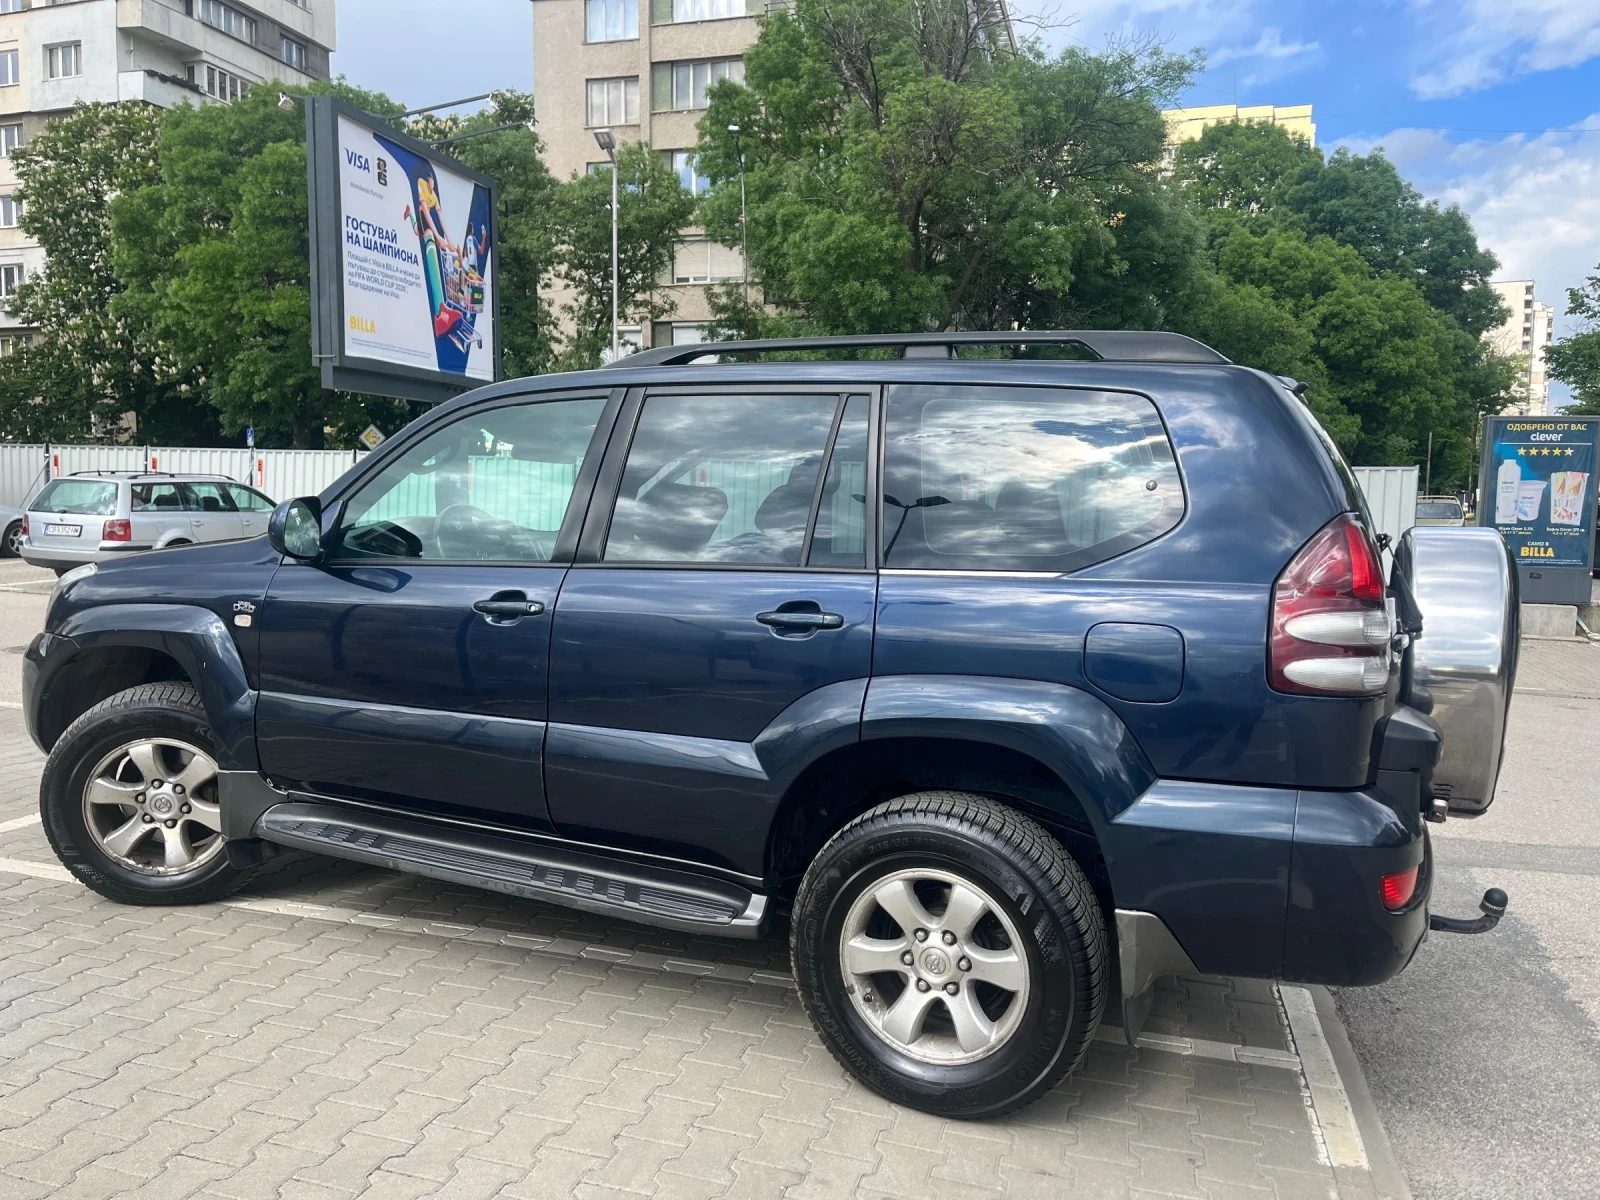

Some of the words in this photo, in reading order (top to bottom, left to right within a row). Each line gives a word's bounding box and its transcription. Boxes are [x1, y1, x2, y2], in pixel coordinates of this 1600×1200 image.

[344, 148, 370, 173] VISA
[346, 215, 398, 244] ГОСТУВАЙ
[346, 230, 361, 247] НА
[362, 236, 419, 266] ШАМПИОНА
[347, 251, 368, 263] Плащай
[385, 263, 399, 273] BILLA
[354, 271, 366, 281] FIFA
[365, 274, 385, 286] WORLD
[384, 280, 395, 289] CUP
[349, 315, 376, 334] BILLA
[1506, 423, 1555, 431] ОДОБРЕНО
[1556, 423, 1569, 431] ОТ
[1570, 423, 1588, 431] ВАС
[1530, 432, 1563, 441] clever
[1520, 547, 1555, 557] BILLA
